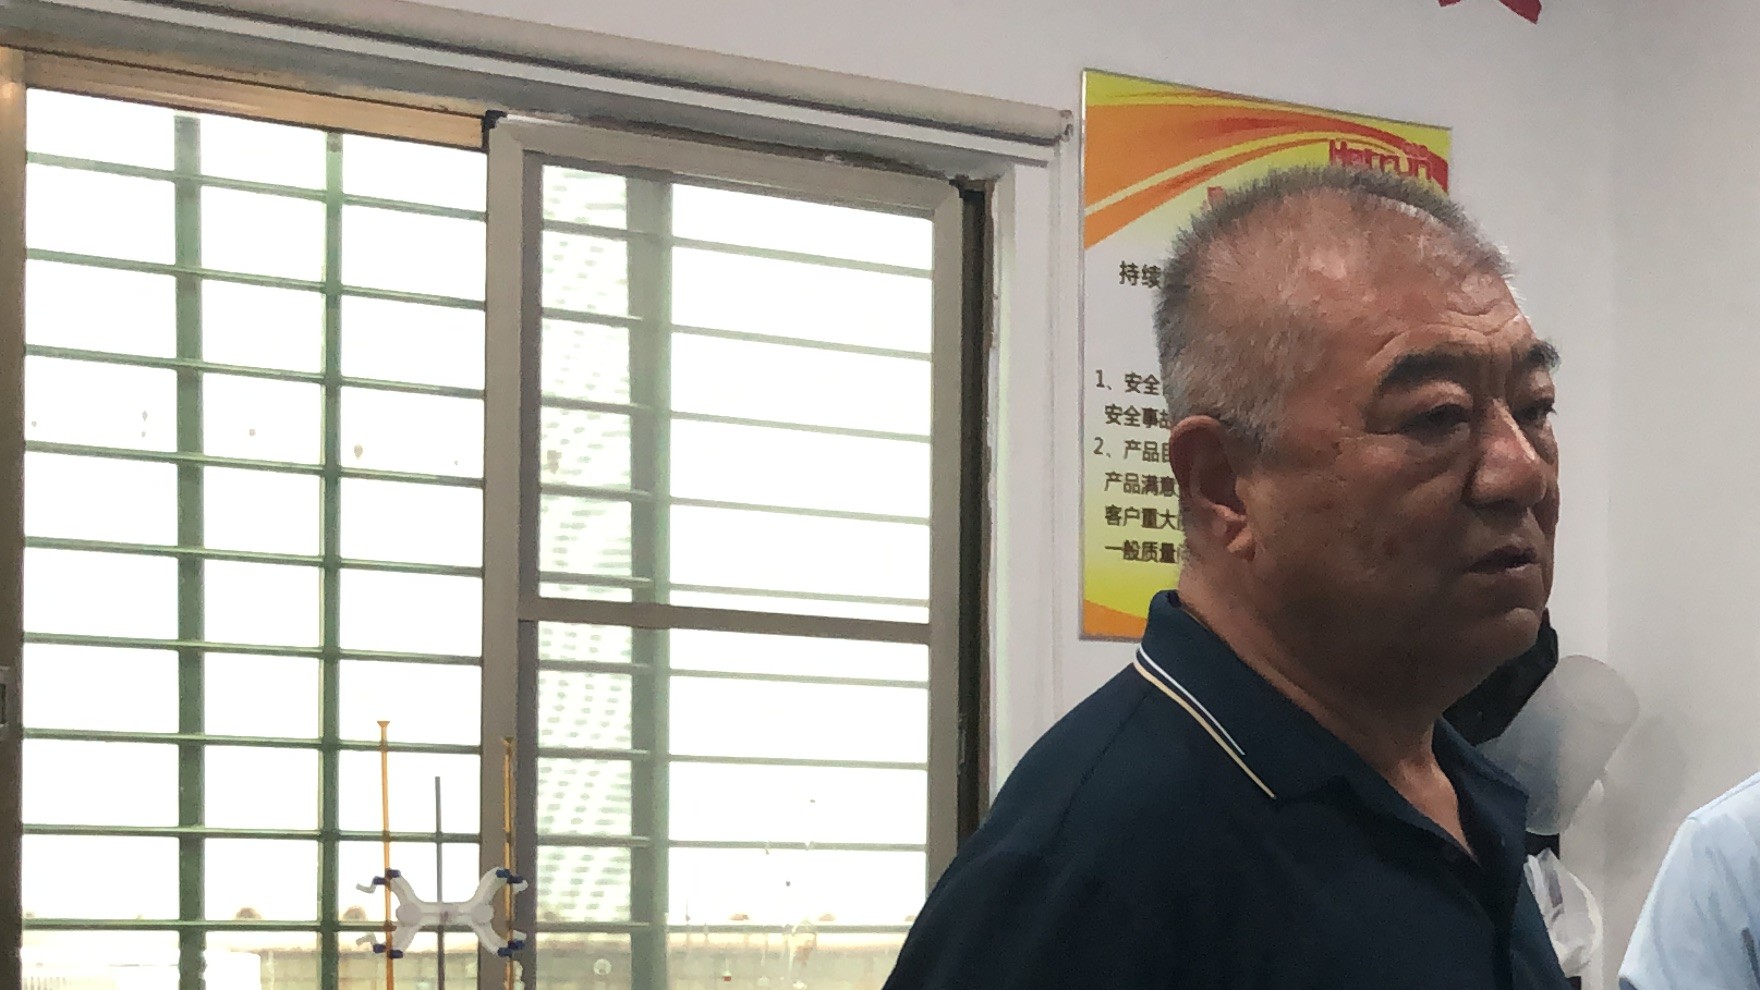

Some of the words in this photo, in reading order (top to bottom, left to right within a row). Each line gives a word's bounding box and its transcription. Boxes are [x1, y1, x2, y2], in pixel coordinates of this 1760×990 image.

[1104, 471, 1179, 497] 产品满意
[1104, 504, 1184, 531] 客户重大
[1104, 540, 1182, 564] 一般质量
